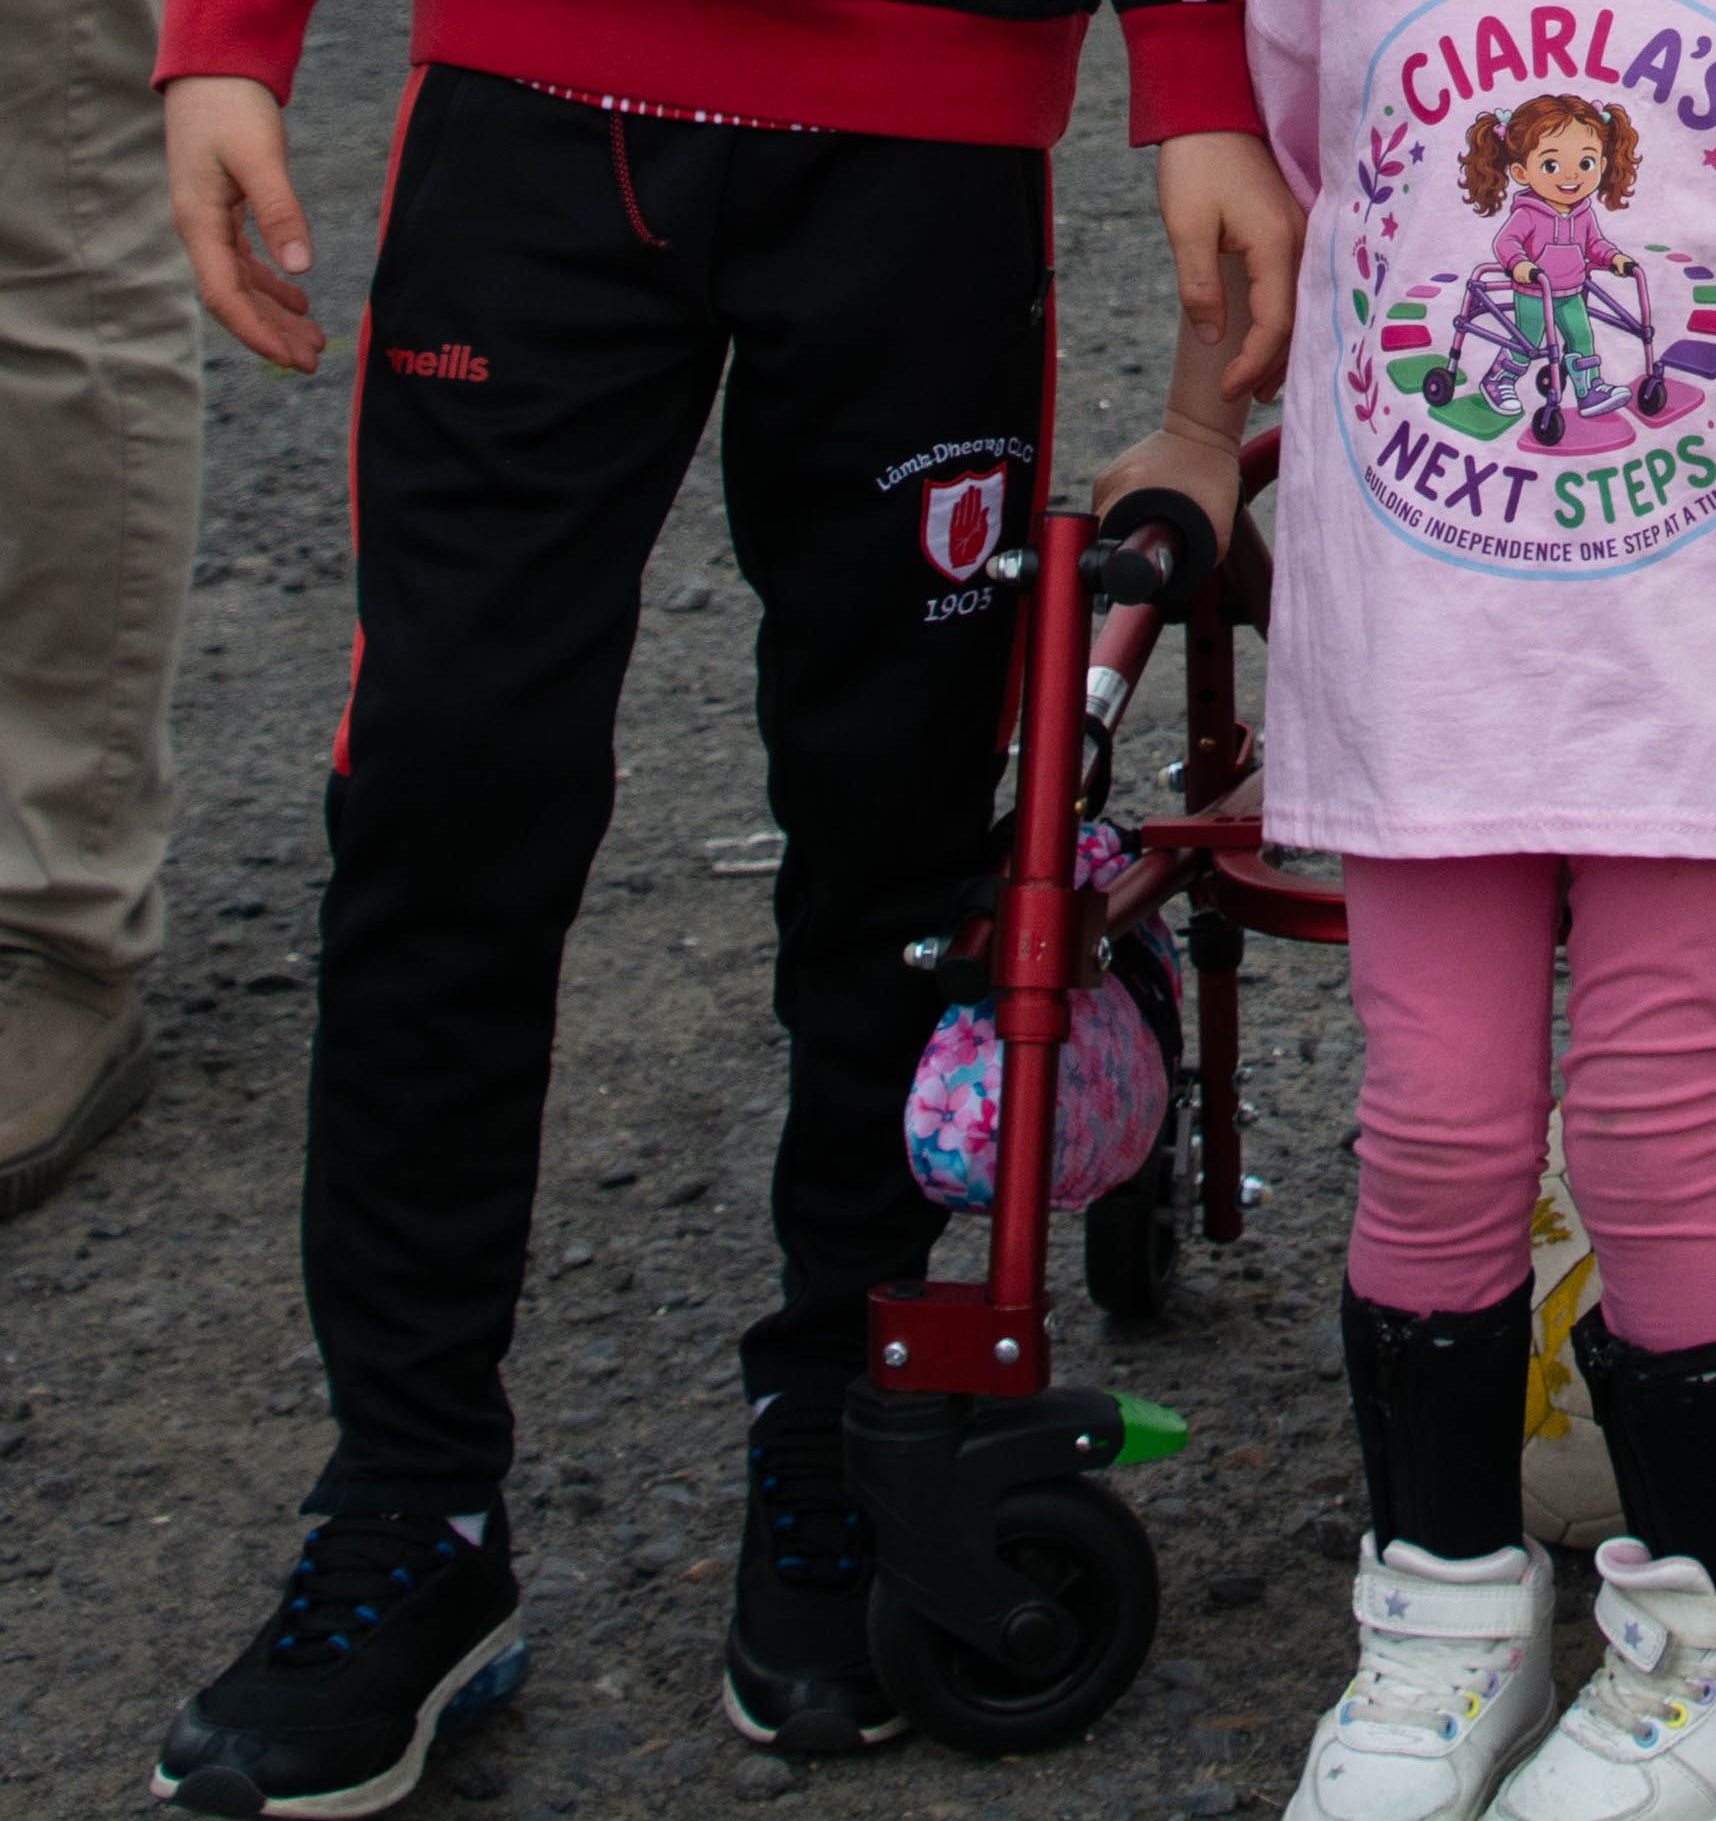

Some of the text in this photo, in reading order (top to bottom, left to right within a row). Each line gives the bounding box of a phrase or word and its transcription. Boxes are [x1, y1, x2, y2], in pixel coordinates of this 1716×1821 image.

[1364, 465, 1422, 527] BUILDING
[1424, 516, 1573, 563] INDEPENDENCE
[1580, 538, 1618, 562] ONE
[1625, 527, 1661, 555] STEP
[1665, 518, 1680, 538] AT
[1683, 506, 1697, 524] A
[1376, 419, 1539, 524] NEXT
